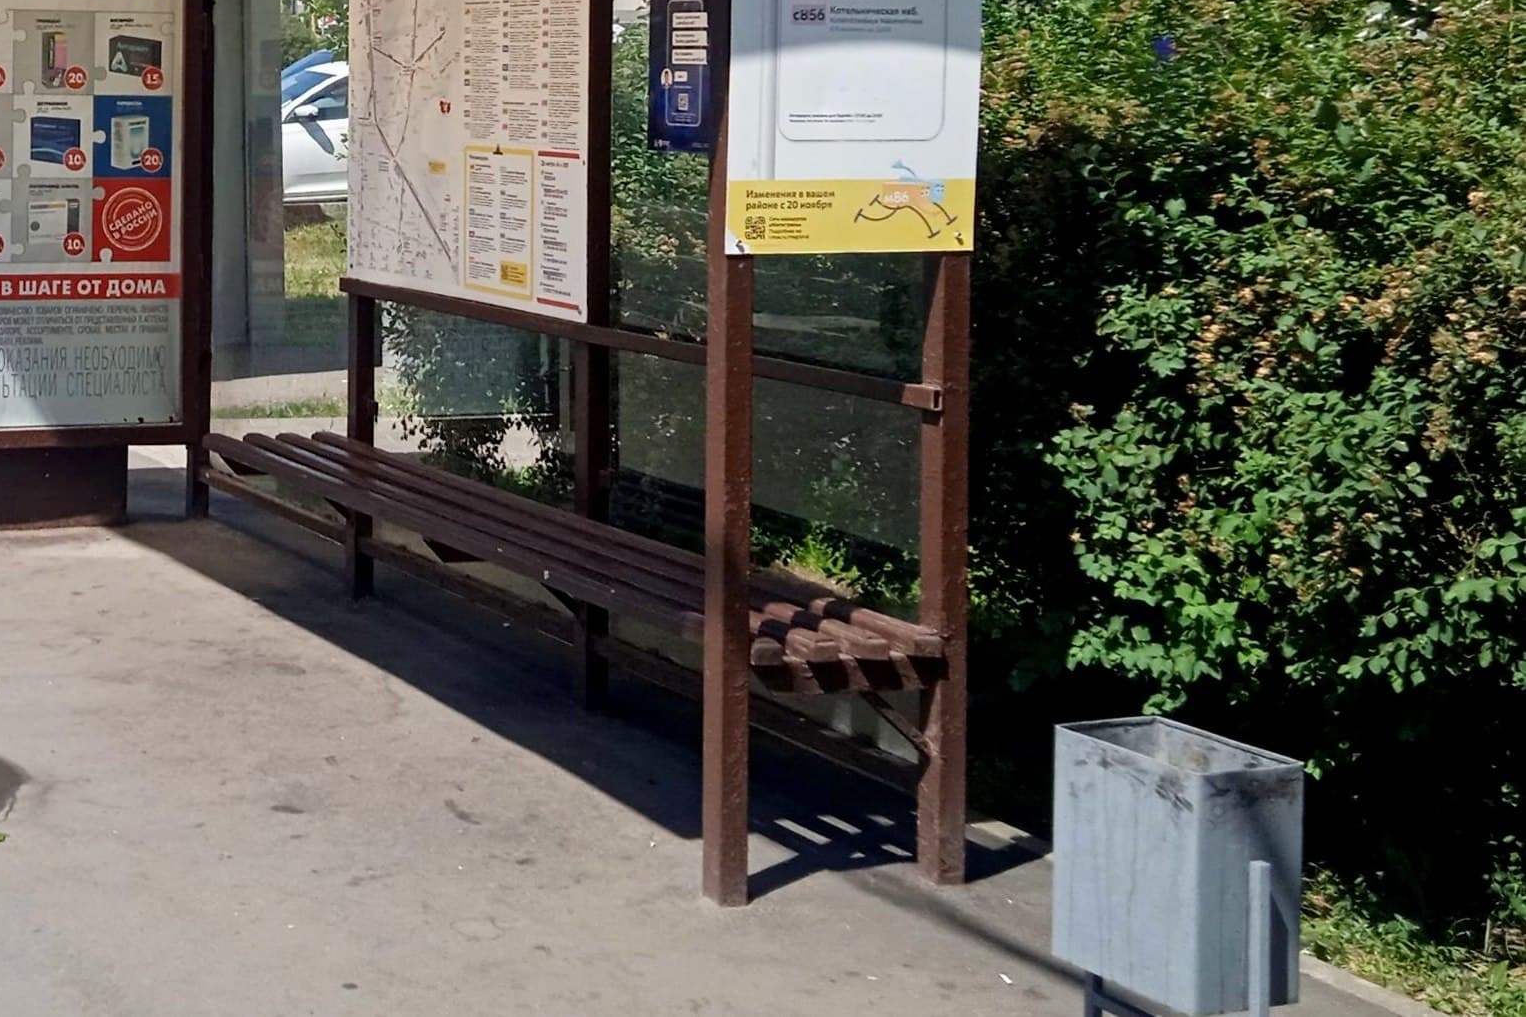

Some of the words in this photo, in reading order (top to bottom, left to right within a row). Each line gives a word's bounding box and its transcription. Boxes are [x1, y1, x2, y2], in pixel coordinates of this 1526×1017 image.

[746, 190, 797, 199] Изменения
[806, 191, 835, 199] вашем
[746, 200, 779, 212] районе
[780, 202, 786, 210] с
[786, 200, 799, 210] 20
[800, 199, 833, 210] ноября
[109, 201, 153, 231] СДЕЛАНО
[113, 231, 121, 239] В
[121, 208, 157, 234] РОССИИ
[1, 281, 12, 295] В
[19, 280, 71, 295] ШАГЕ
[77, 280, 101, 295] ОТ
[106, 279, 166, 297] ДОМА
[75, 345, 166, 371] НЕОБХОДИМО
[66, 370, 168, 398] СПЕЦИАЛИСТА
